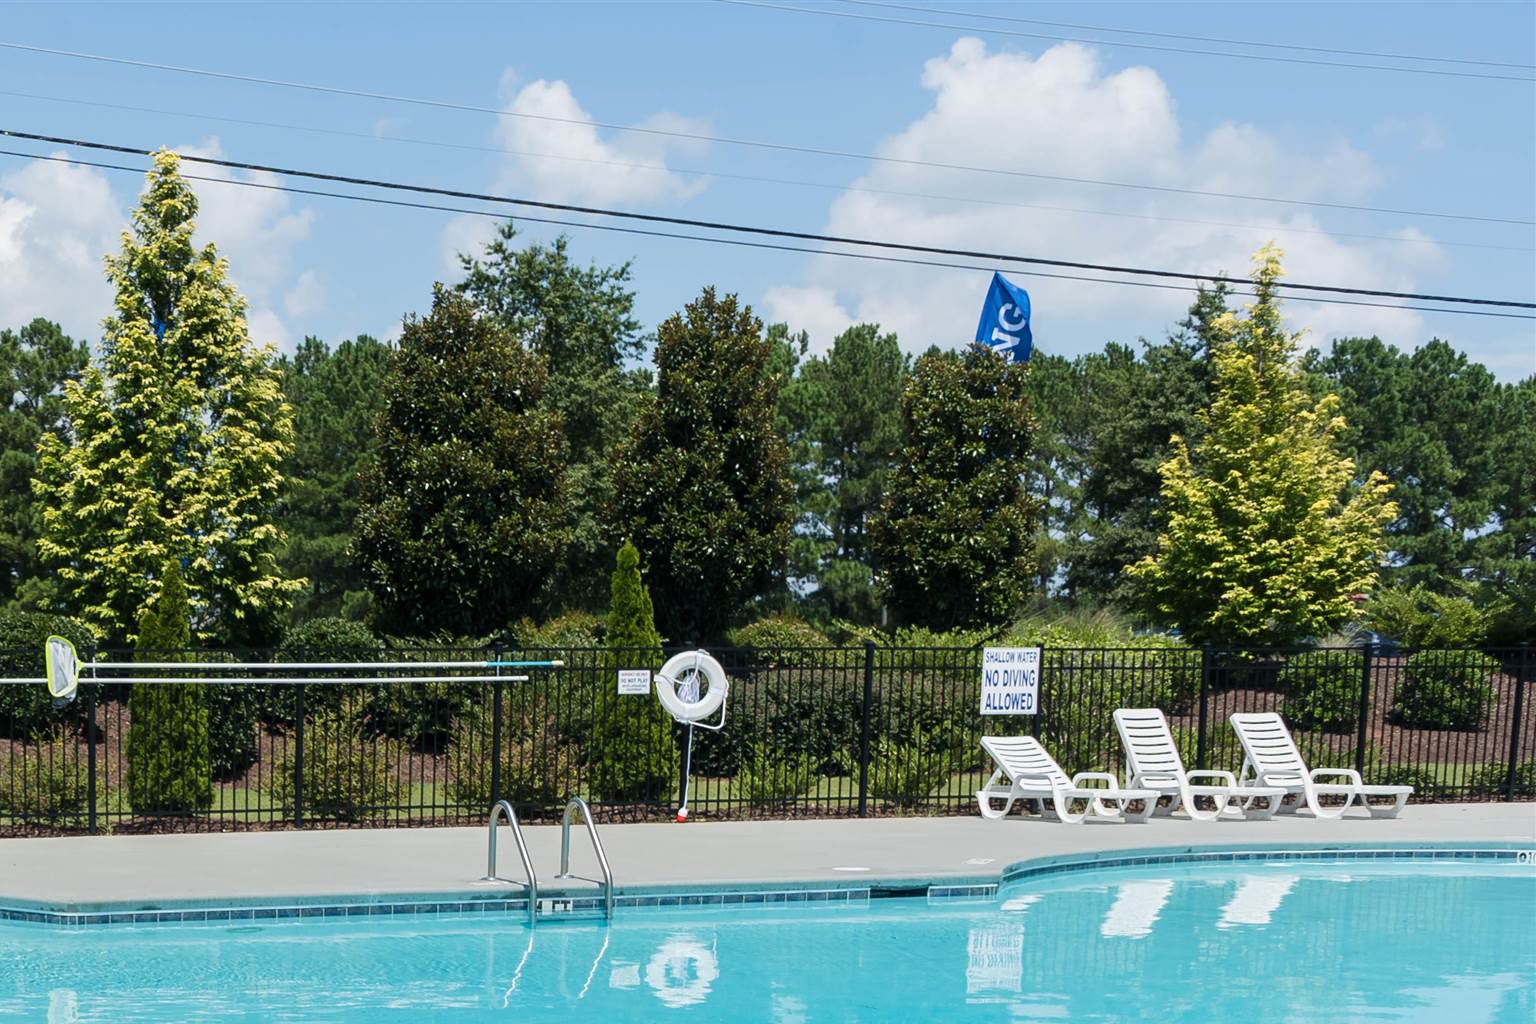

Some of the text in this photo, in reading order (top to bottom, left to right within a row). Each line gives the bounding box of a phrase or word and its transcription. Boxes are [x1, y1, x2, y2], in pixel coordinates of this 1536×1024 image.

[985, 651, 1037, 663] SHALLOW WATER
[985, 669, 1035, 687] NO DIVING
[984, 692, 1033, 710] ALLOWED
